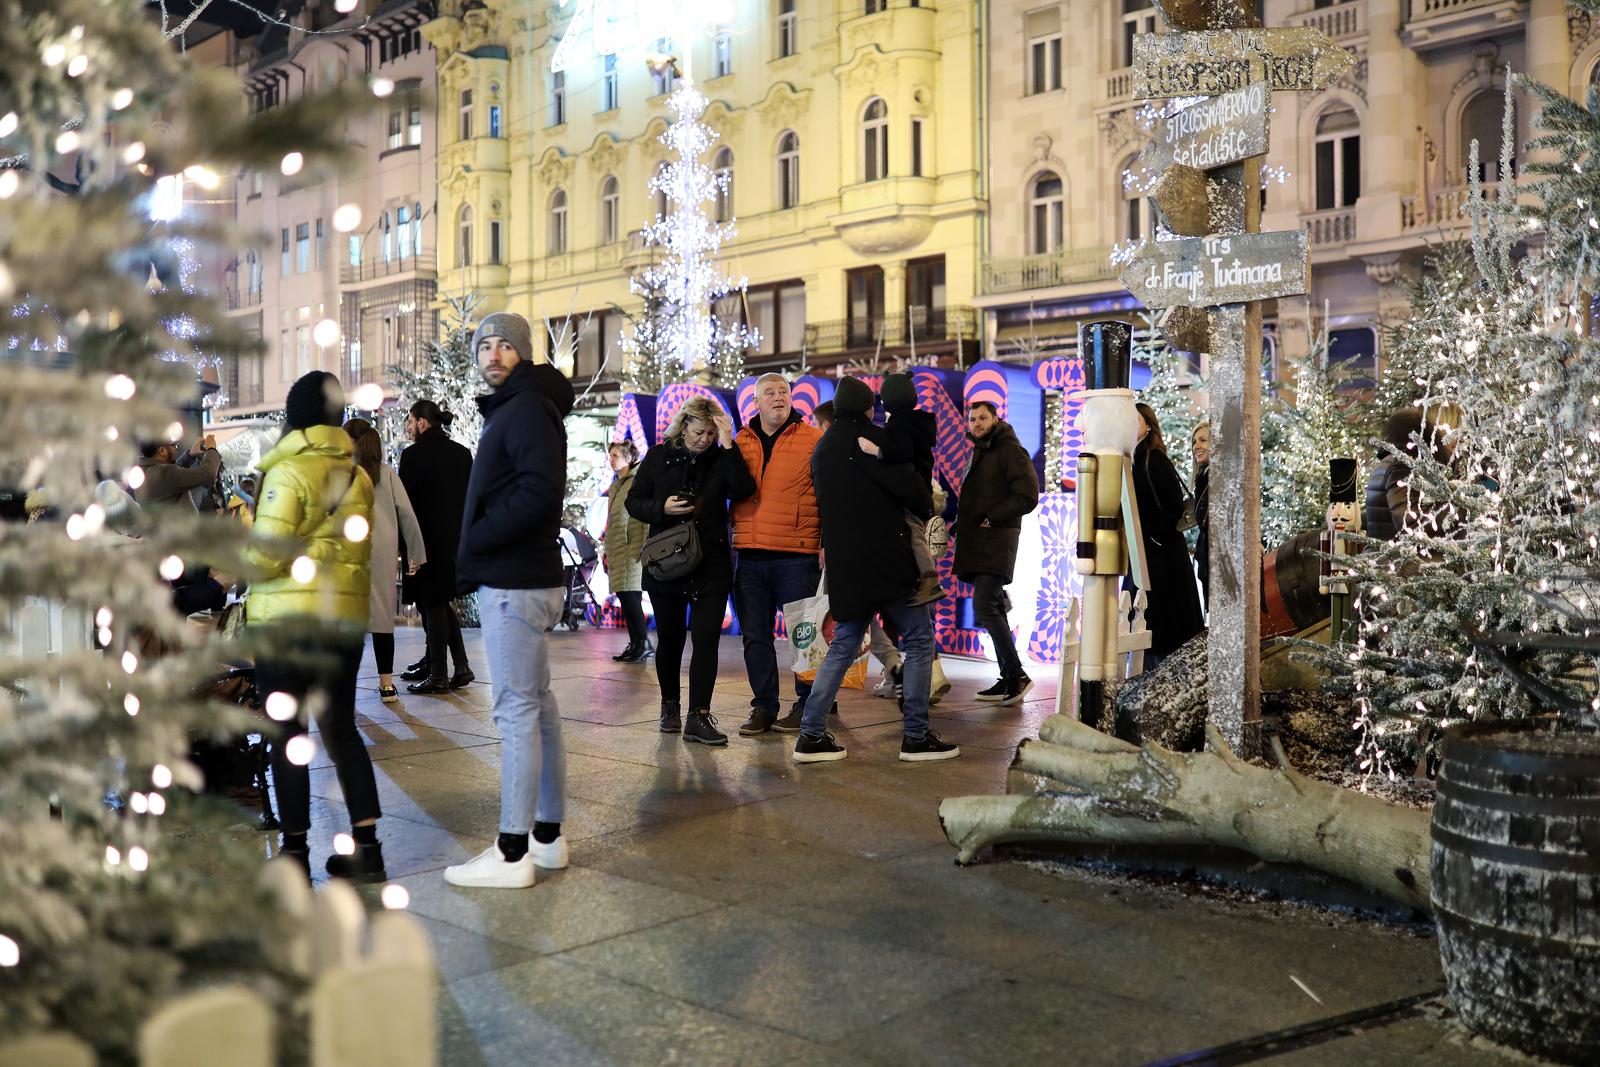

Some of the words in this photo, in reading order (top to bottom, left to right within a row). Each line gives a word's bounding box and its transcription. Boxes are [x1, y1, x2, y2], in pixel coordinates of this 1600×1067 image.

[1259, 52, 1317, 88] TRGU
[1202, 237, 1231, 256] Trg
[1164, 262, 1204, 302] Franje
[796, 625, 812, 639] BIO
